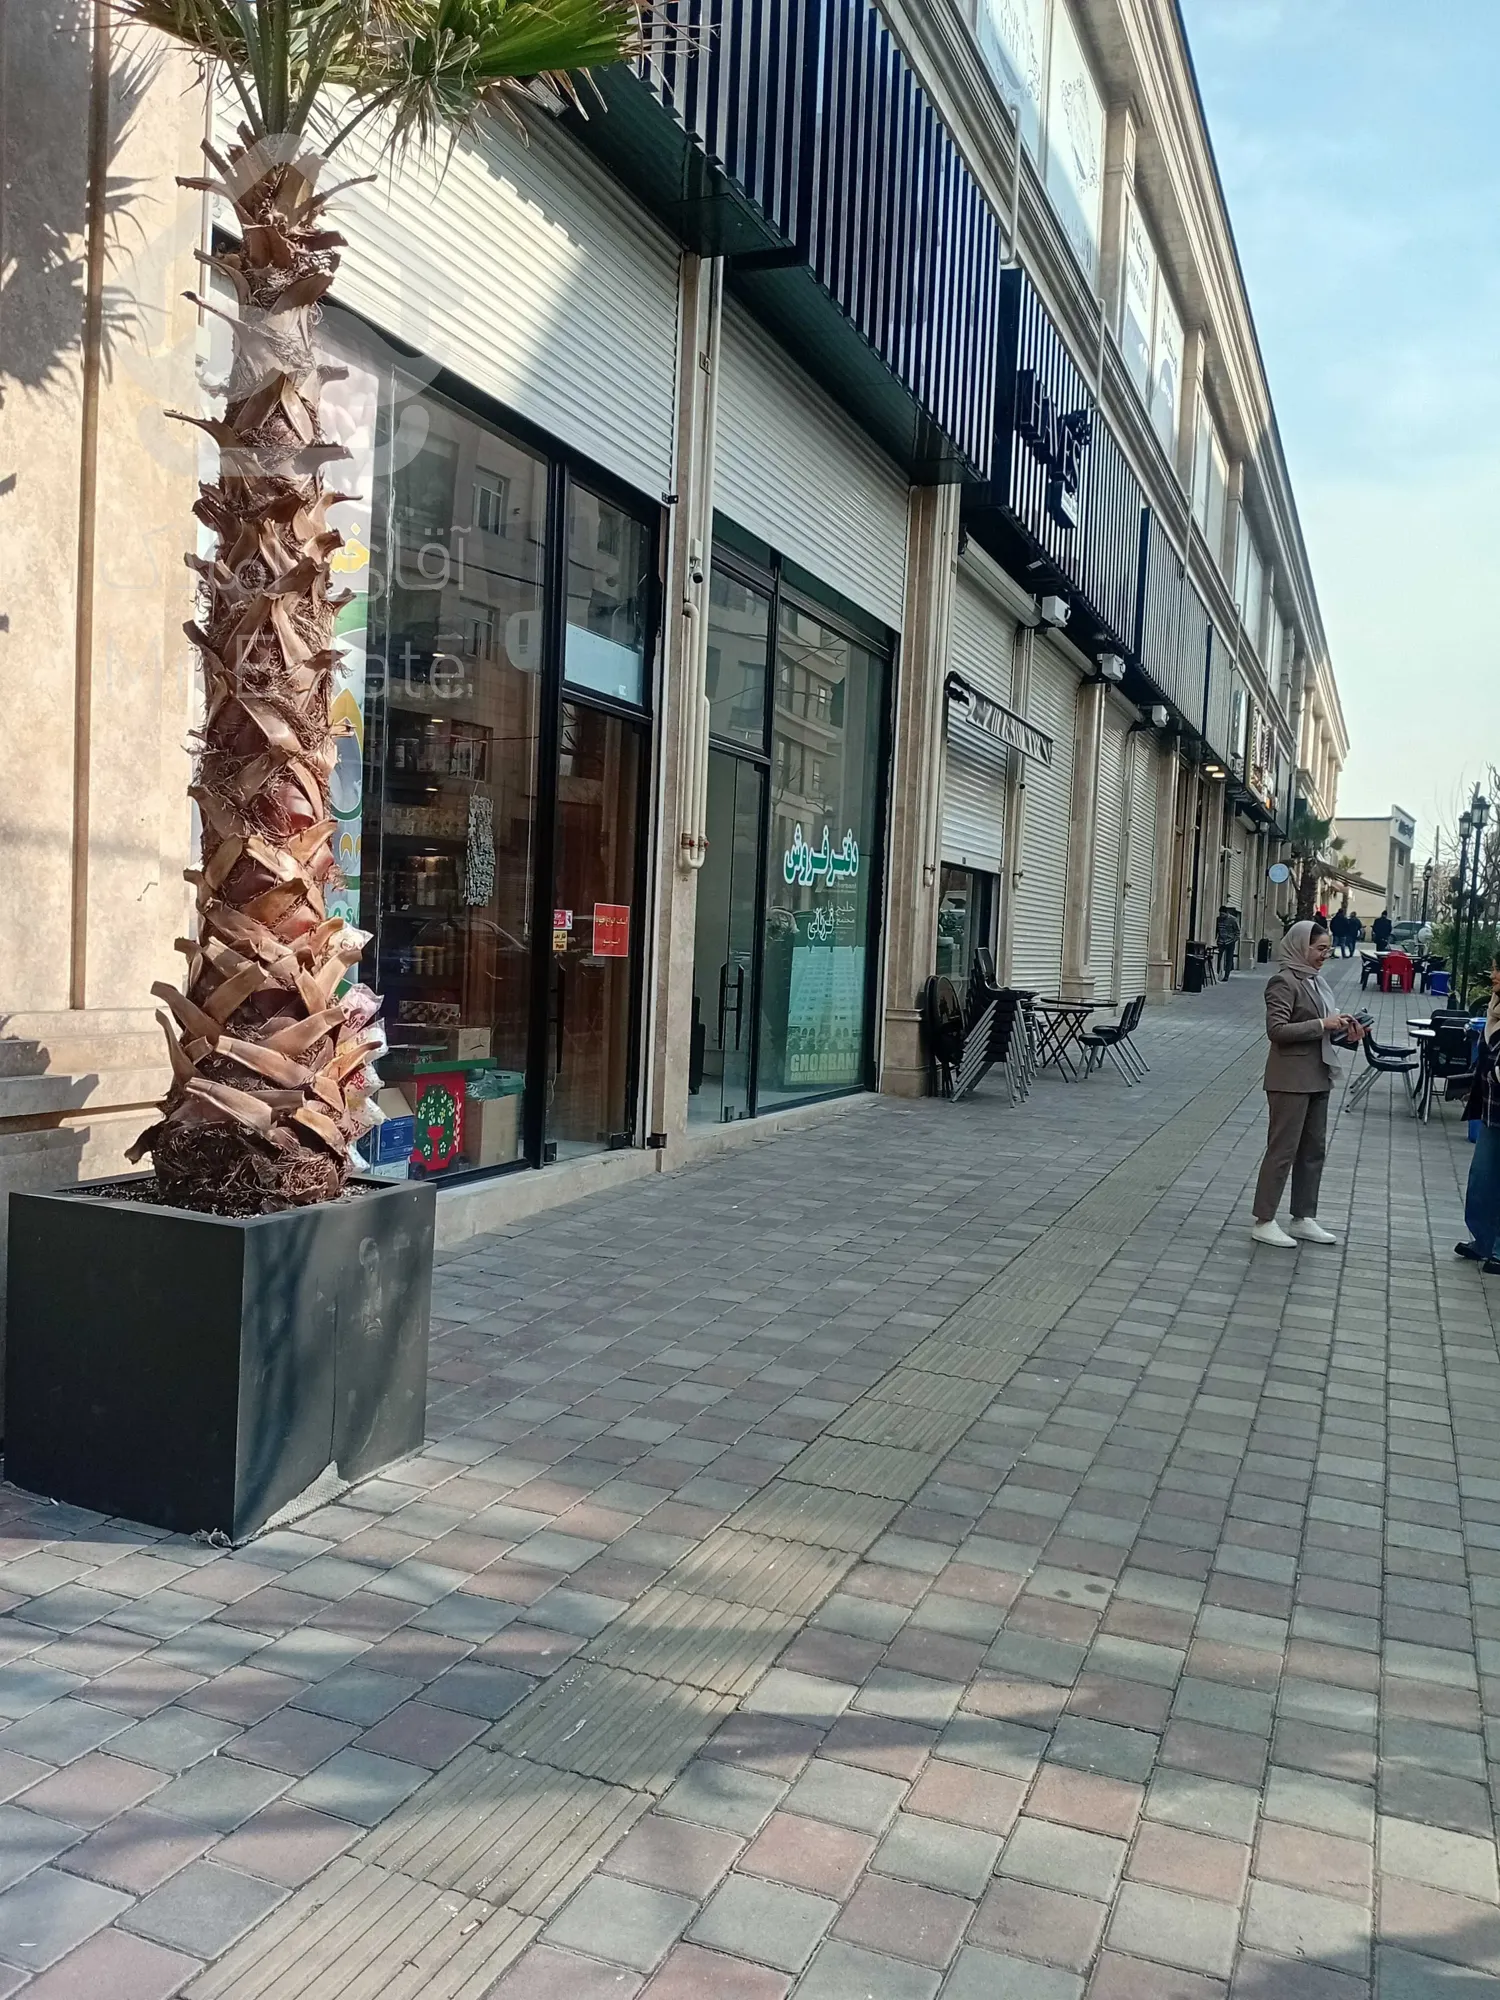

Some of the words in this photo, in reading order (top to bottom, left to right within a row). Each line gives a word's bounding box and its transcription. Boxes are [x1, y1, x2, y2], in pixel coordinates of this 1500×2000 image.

[783, 822, 829, 887] فروش
[825, 828, 859, 887] دفتر
[790, 1052, 860, 1072] GHORBANI
